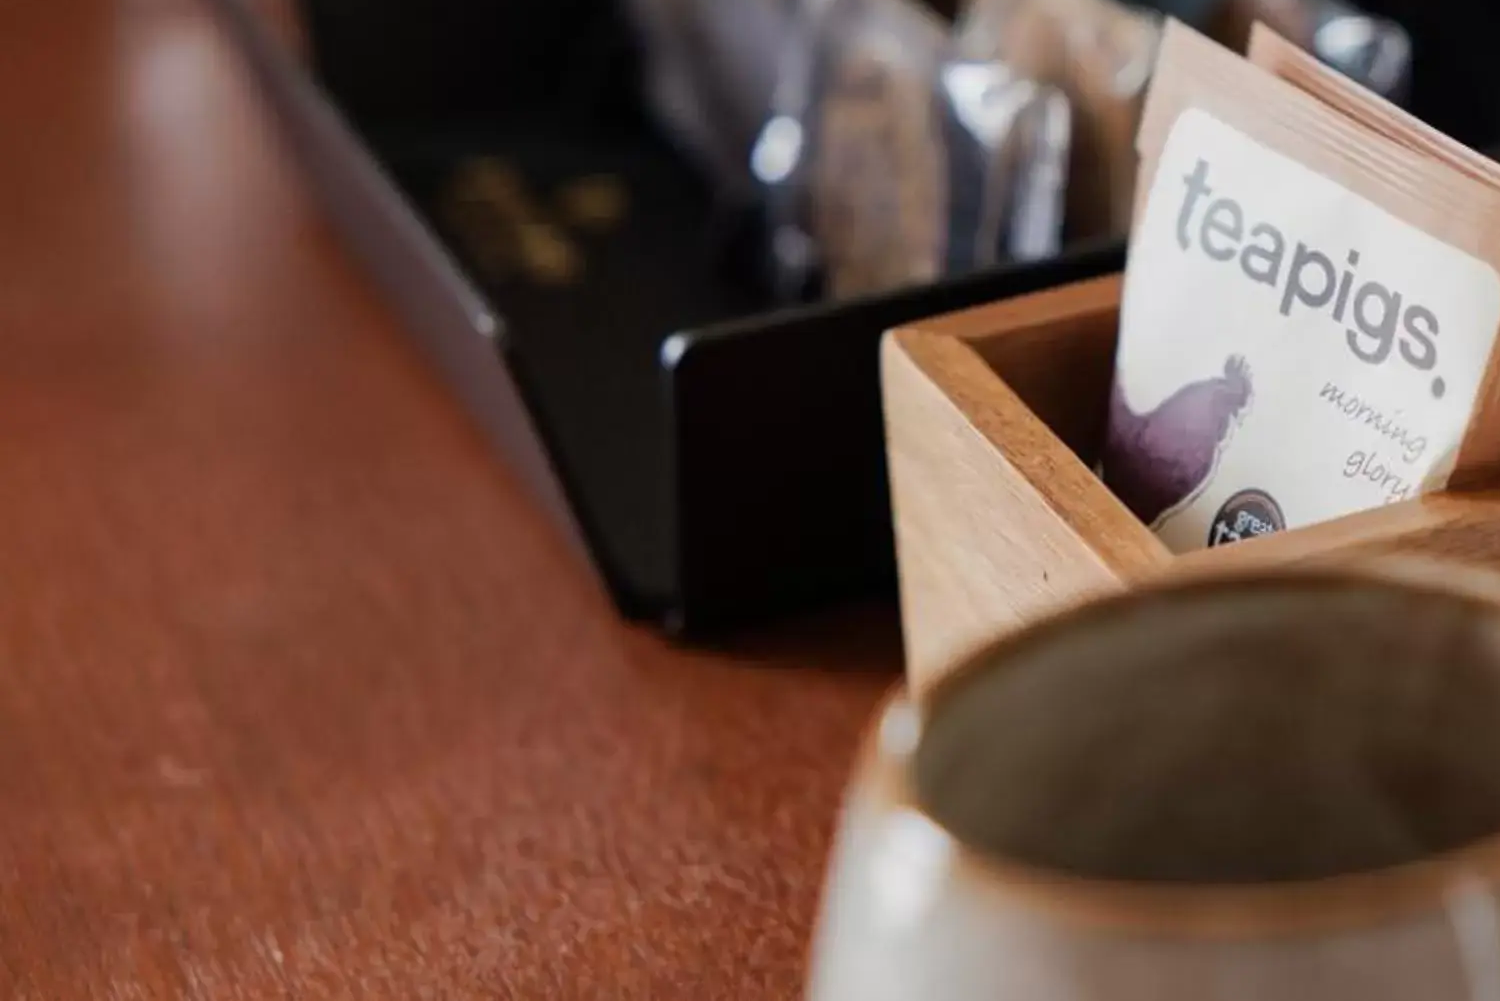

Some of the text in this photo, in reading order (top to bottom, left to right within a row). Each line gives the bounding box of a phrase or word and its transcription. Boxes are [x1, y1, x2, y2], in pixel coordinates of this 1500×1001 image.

[1175, 159, 1446, 399] teapigs.
[1319, 381, 1427, 464] morning
[1343, 450, 1412, 503] glory
